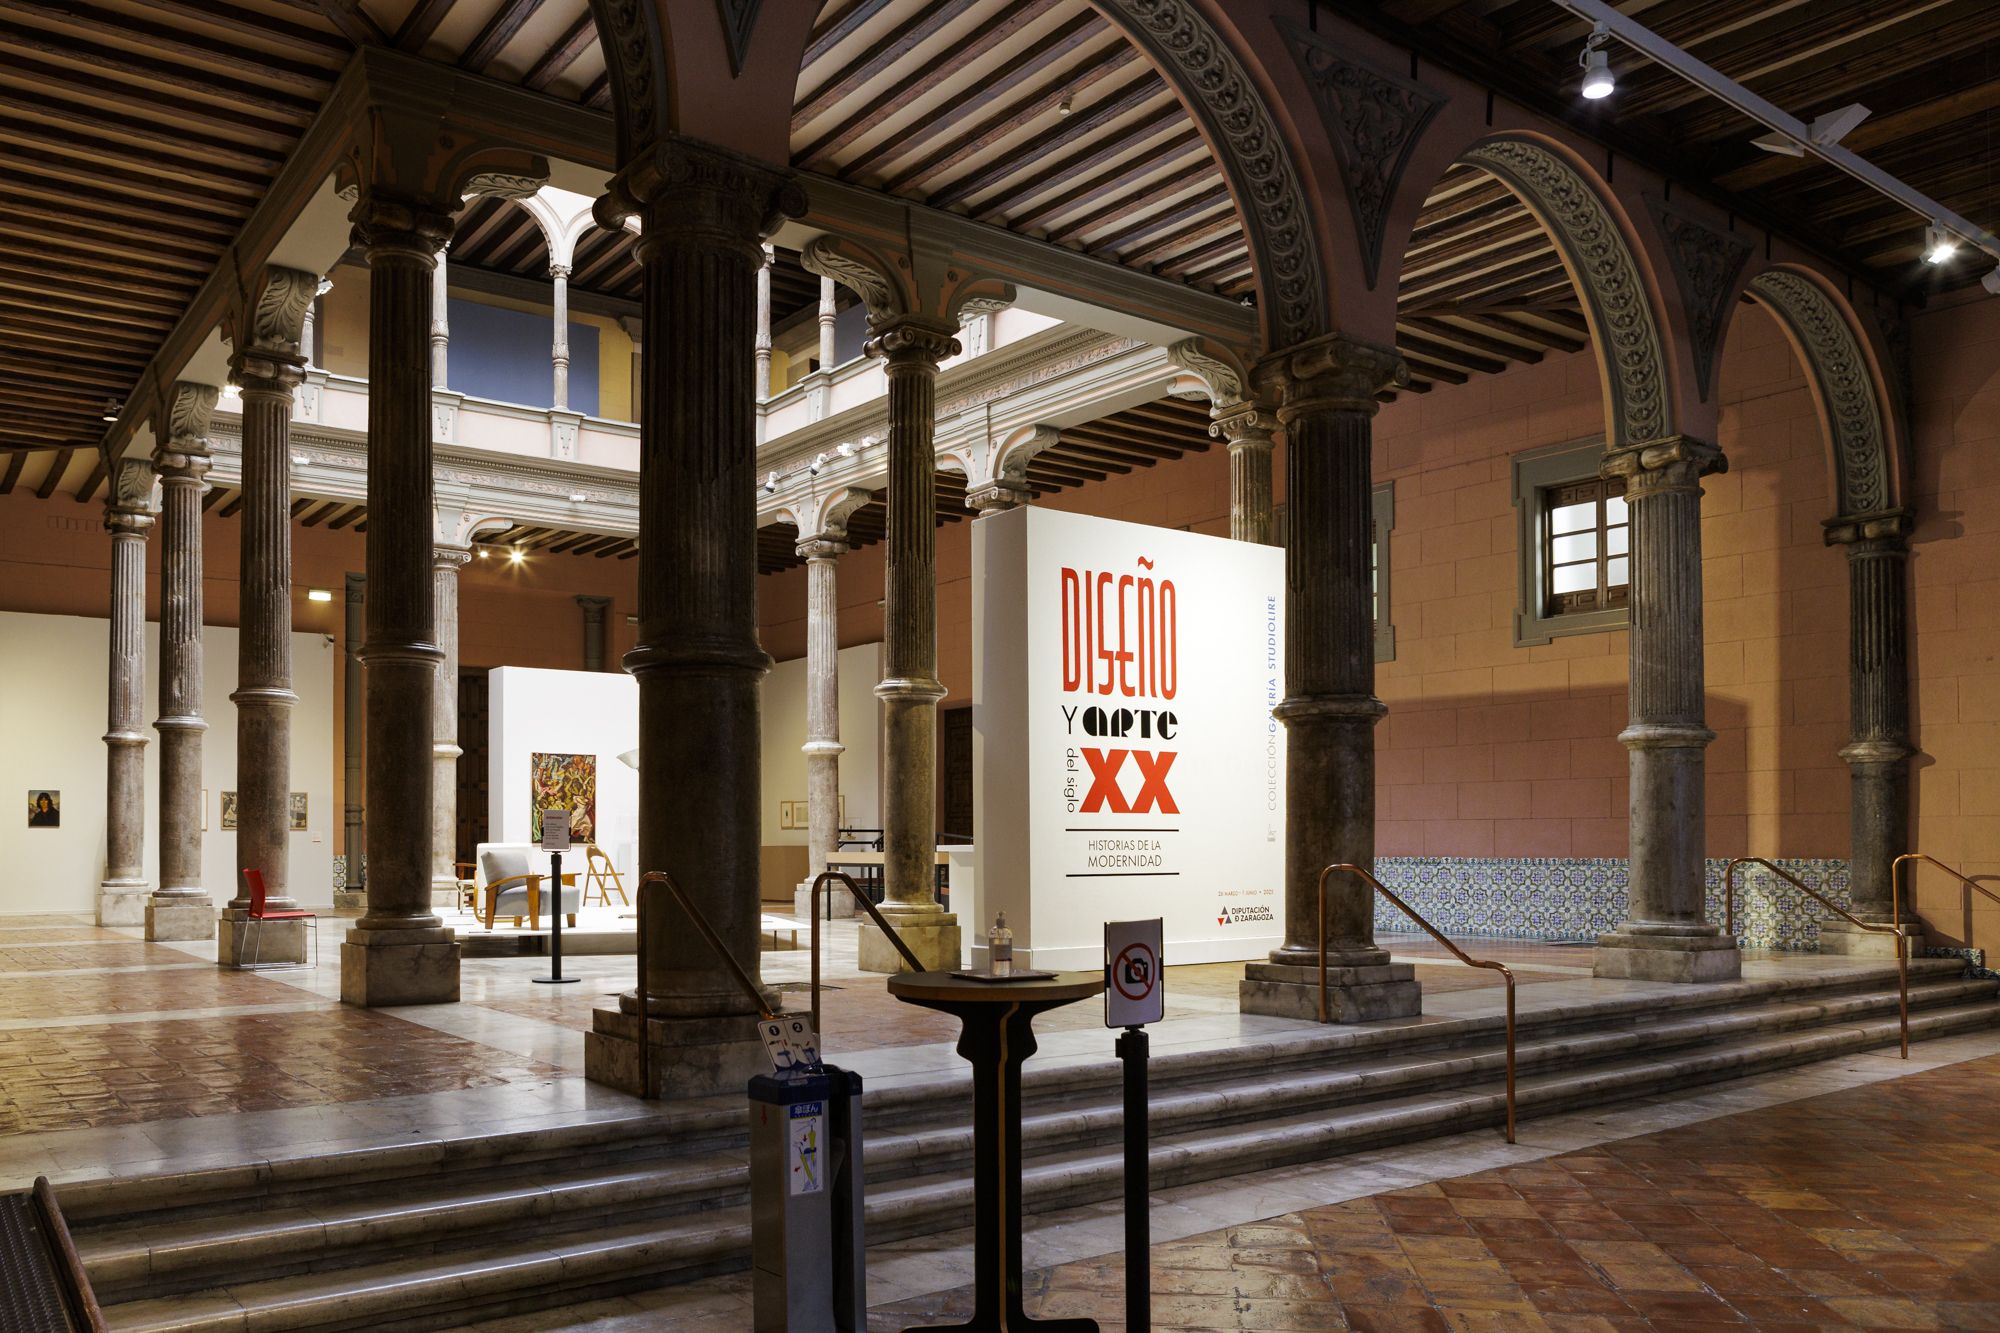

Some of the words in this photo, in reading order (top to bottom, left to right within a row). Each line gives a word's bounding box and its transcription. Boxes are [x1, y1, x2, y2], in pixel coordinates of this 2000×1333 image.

[1061, 556, 1177, 700] DISEÑO
[1267, 595, 1276, 670] STUDIOLIRE
[1061, 704, 1078, 735] Y
[1266, 679, 1277, 733] GAERÍA
[1066, 747, 1079, 772] del
[1063, 776, 1079, 813] siglo
[1079, 747, 1181, 815] XX
[1088, 839, 1135, 851] HISTORIAS
[1137, 840, 1149, 851] DE
[1151, 840, 1162, 851] LA
[1088, 854, 1162, 868] MODERNIDAD
[1231, 904, 1270, 914] DIPUTACIÓN
